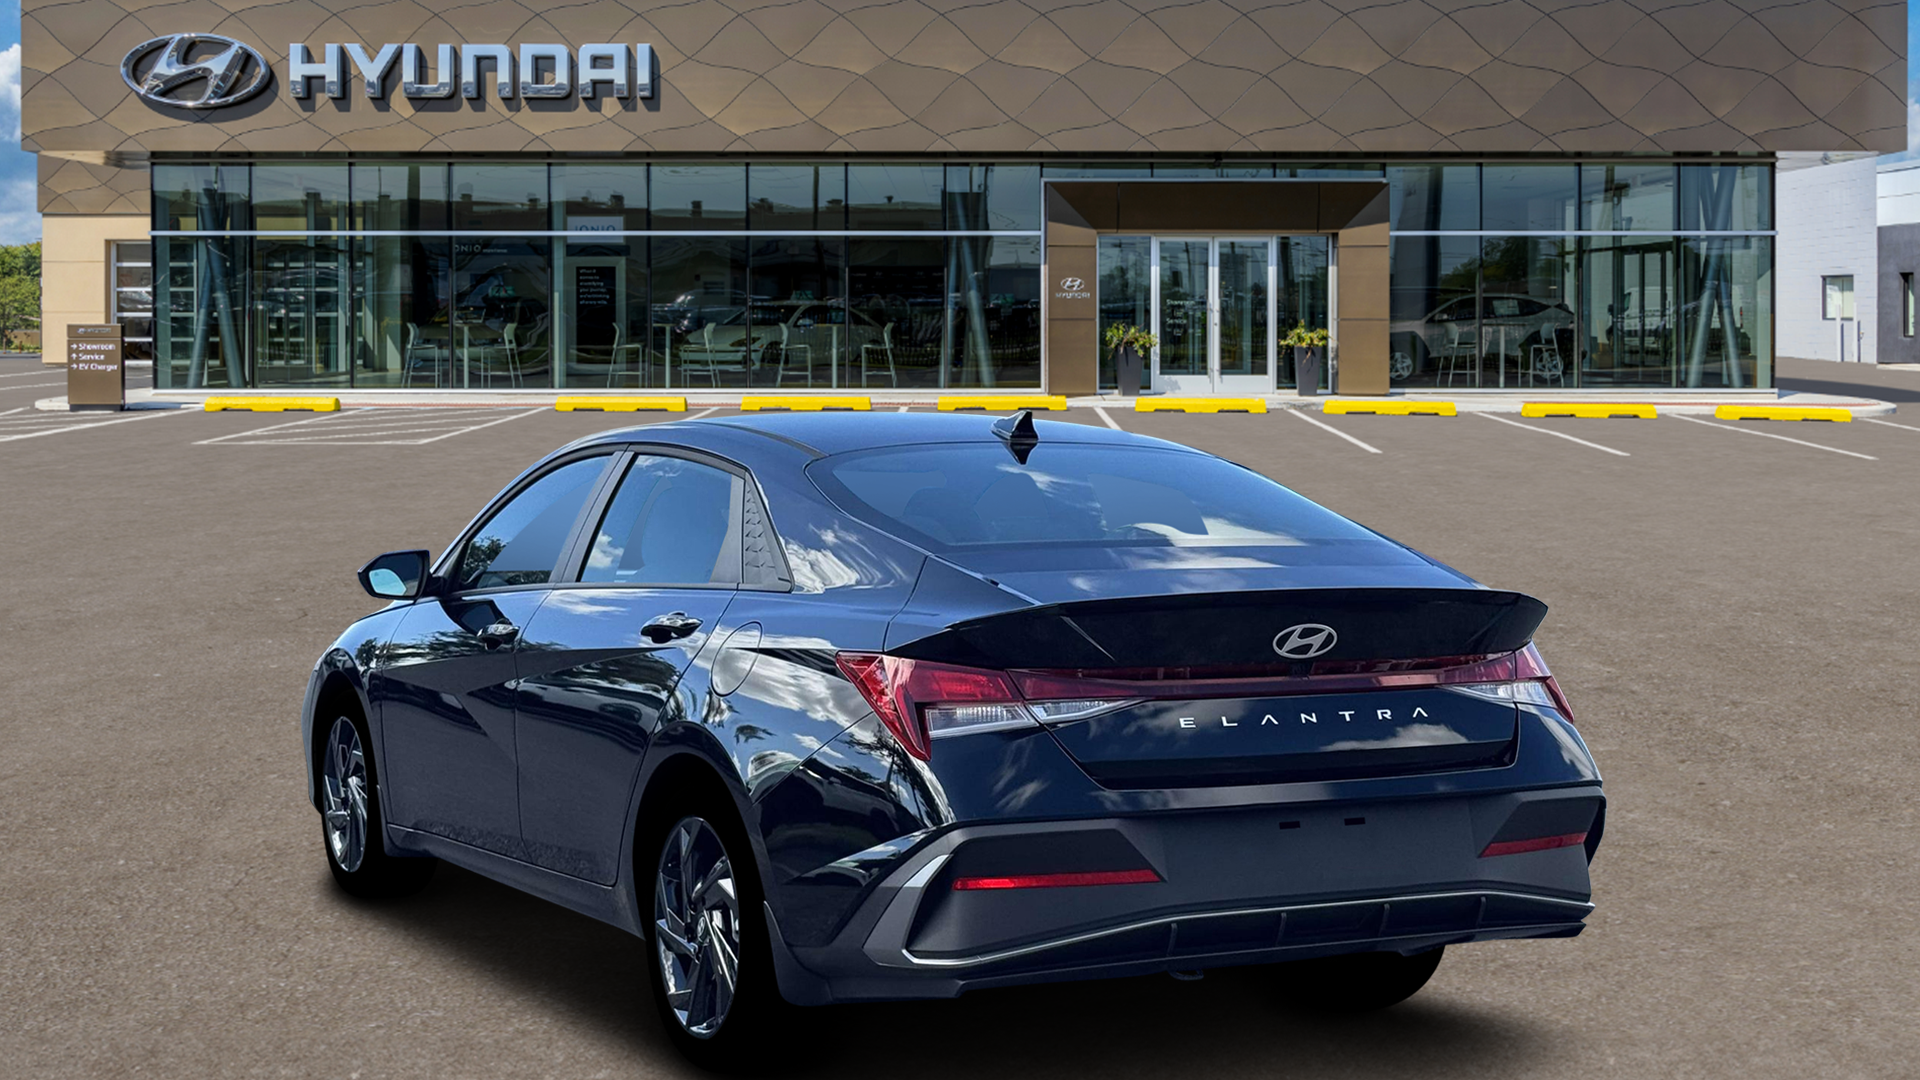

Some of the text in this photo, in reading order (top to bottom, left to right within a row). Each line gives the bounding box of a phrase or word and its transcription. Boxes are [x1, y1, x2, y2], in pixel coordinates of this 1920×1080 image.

[289, 43, 653, 99] HYUNDAI
[78, 352, 105, 360] Service
[90, 363, 118, 372] Charger
[1179, 707, 1429, 728] ELANTRA
